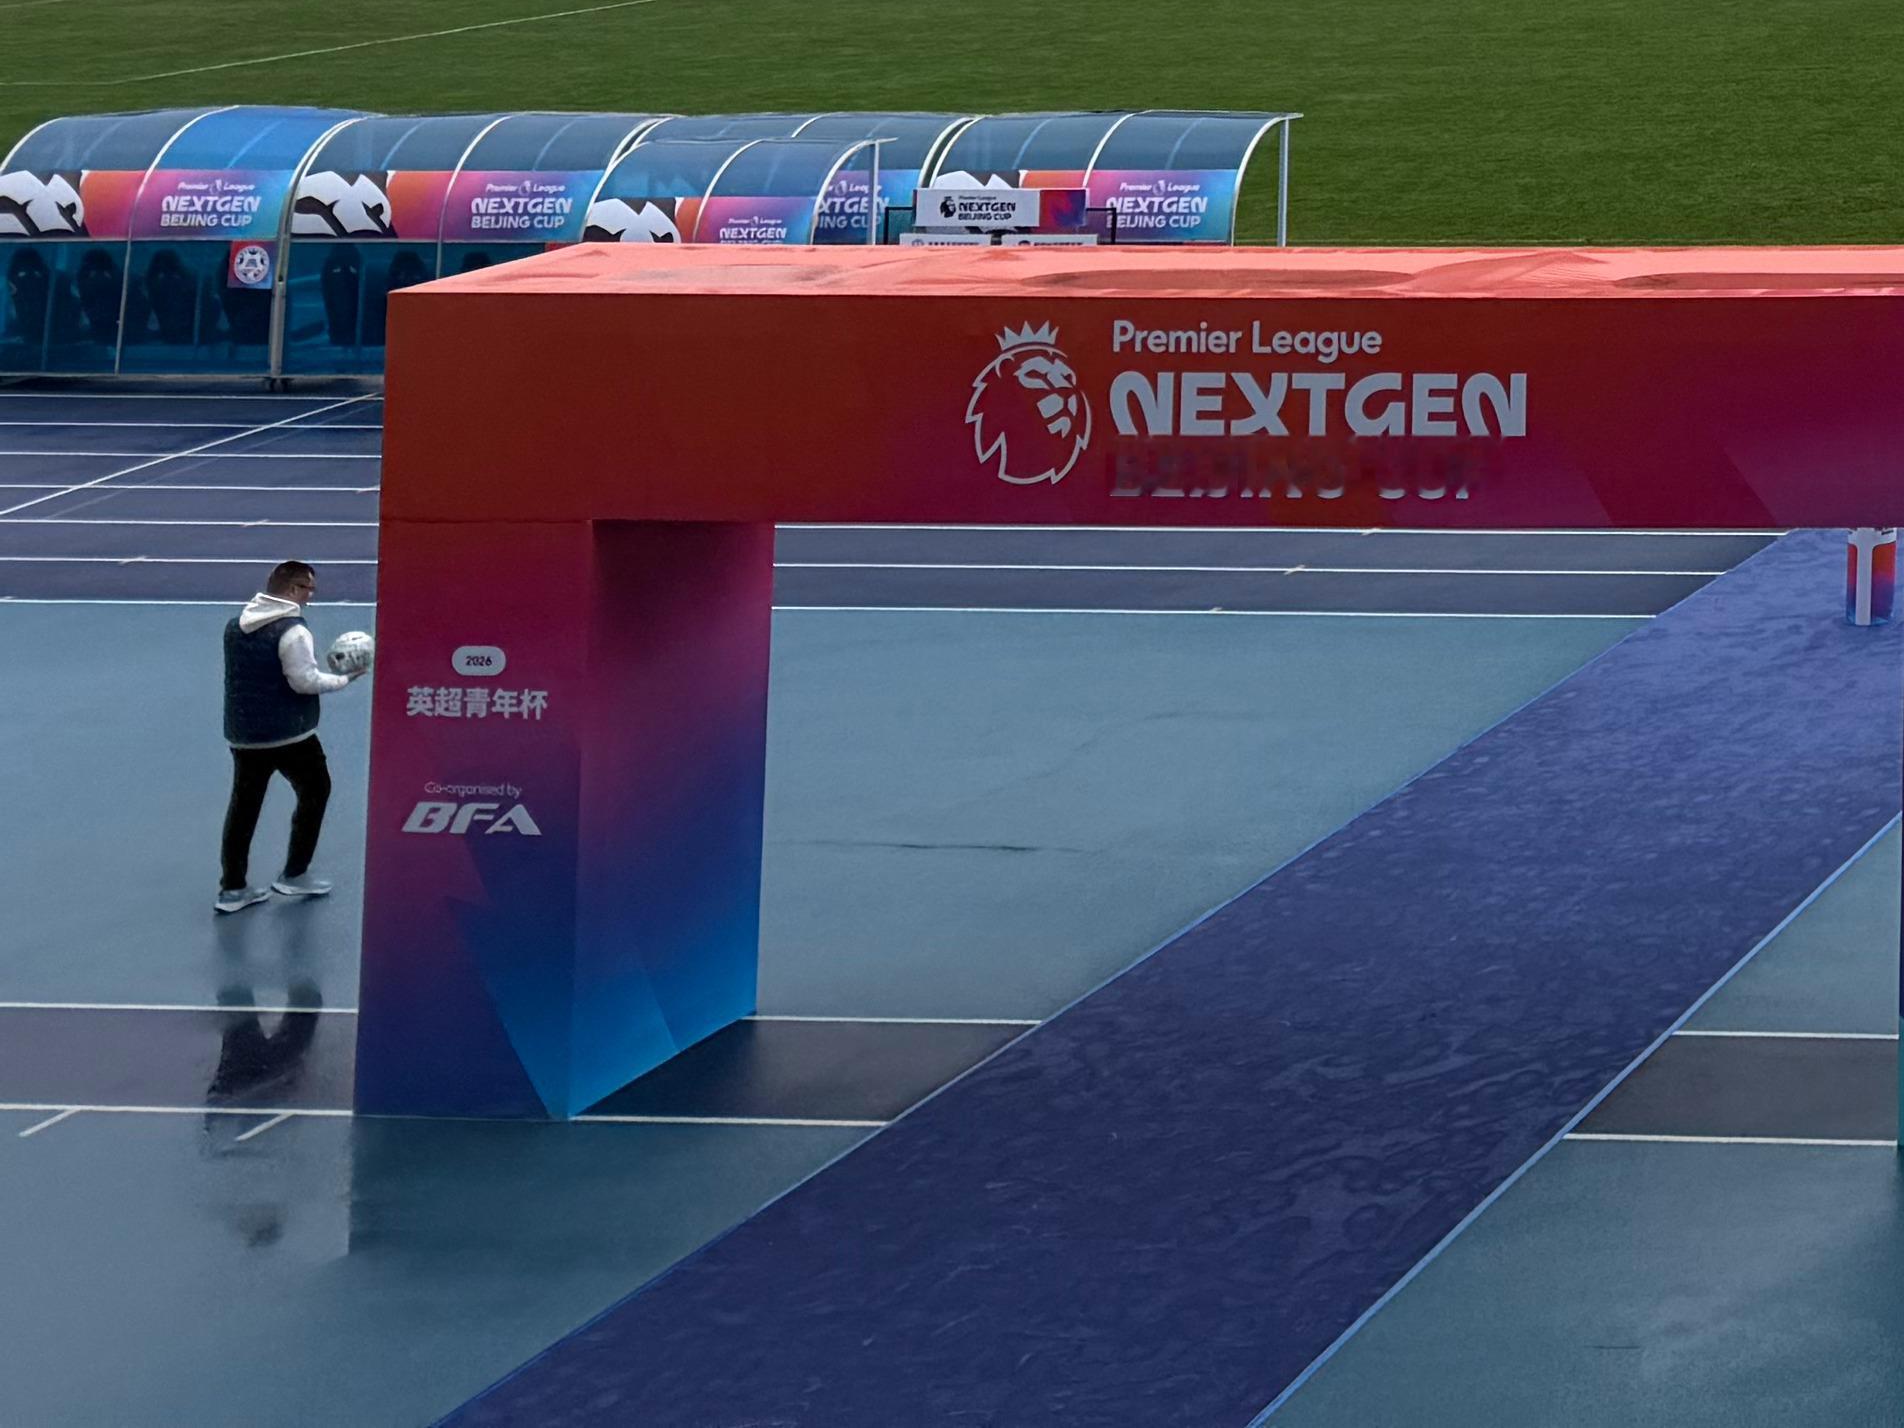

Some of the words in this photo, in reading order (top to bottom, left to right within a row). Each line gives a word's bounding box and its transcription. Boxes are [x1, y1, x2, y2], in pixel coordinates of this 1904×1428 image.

[1120, 183, 1153, 191] Premier
[1167, 183, 1201, 194] League
[161, 196, 262, 212] NEXTGEN
[471, 198, 573, 213] NEXTGEN
[958, 202, 1016, 212] NEXTGEN
[1106, 197, 1208, 213] NEXTGEN
[160, 214, 218, 227] BEIJING
[221, 215, 253, 228] CUP
[471, 215, 530, 229] BEIJING
[533, 216, 565, 229] CUP
[958, 213, 992, 221] BEIJING
[994, 213, 1012, 221] CUP
[1169, 216, 1201, 228] CUP
[720, 227, 787, 239] NEXTGEN
[1112, 320, 1241, 355] Premier
[1251, 321, 1382, 363] League
[1109, 371, 1527, 437] NEXTGEN
[465, 655, 493, 666] 2026
[406, 686, 549, 720] 英超青年杯
[401, 801, 543, 836] BFA
